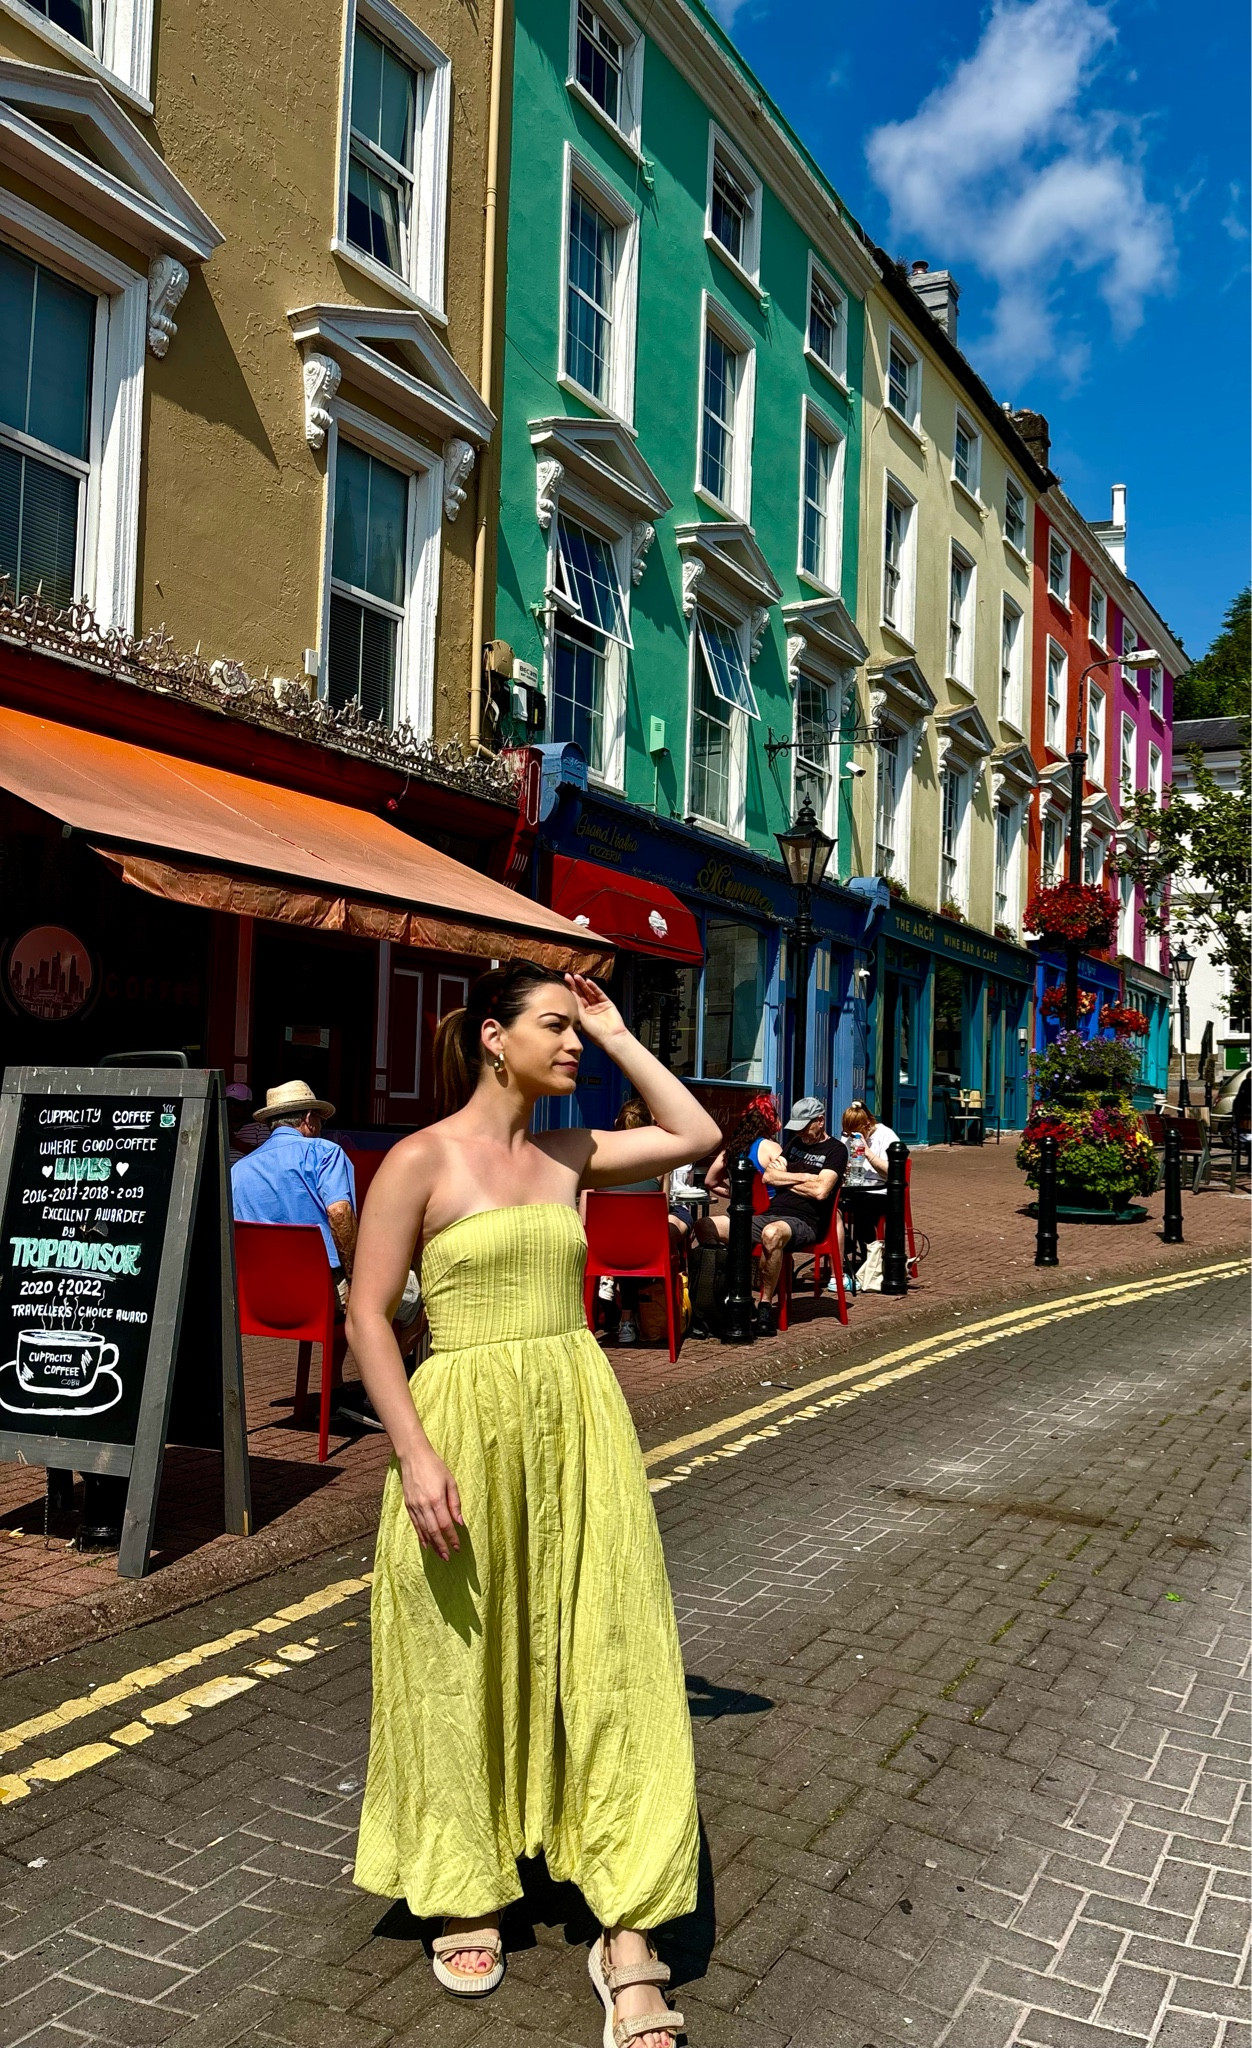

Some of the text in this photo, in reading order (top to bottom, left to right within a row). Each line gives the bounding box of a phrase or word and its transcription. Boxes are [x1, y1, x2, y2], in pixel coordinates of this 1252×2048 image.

[588, 844, 622, 864] PIZZERIA
[895, 916, 910, 933] THE
[912, 923, 935, 942] ARCH
[943, 933, 961, 950] WINE
[962, 941, 975, 955] BAR
[976, 948, 981, 957] &
[39, 1108, 155, 1124] CUPPACITY COFFEE
[39, 1138, 159, 1156] WHERE GOOD COFFEE
[53, 1157, 112, 1182] LIVES
[41, 1206, 147, 1224] EXCELLENT AWARDEE
[9, 1236, 142, 1276] TRIPADVISOR
[19, 1279, 102, 1297] 2020 & 2022
[78, 1305, 114, 1318] CHOICE
[115, 1309, 148, 1323] AWARD
[28, 1351, 73, 1363] CUPPACITY
